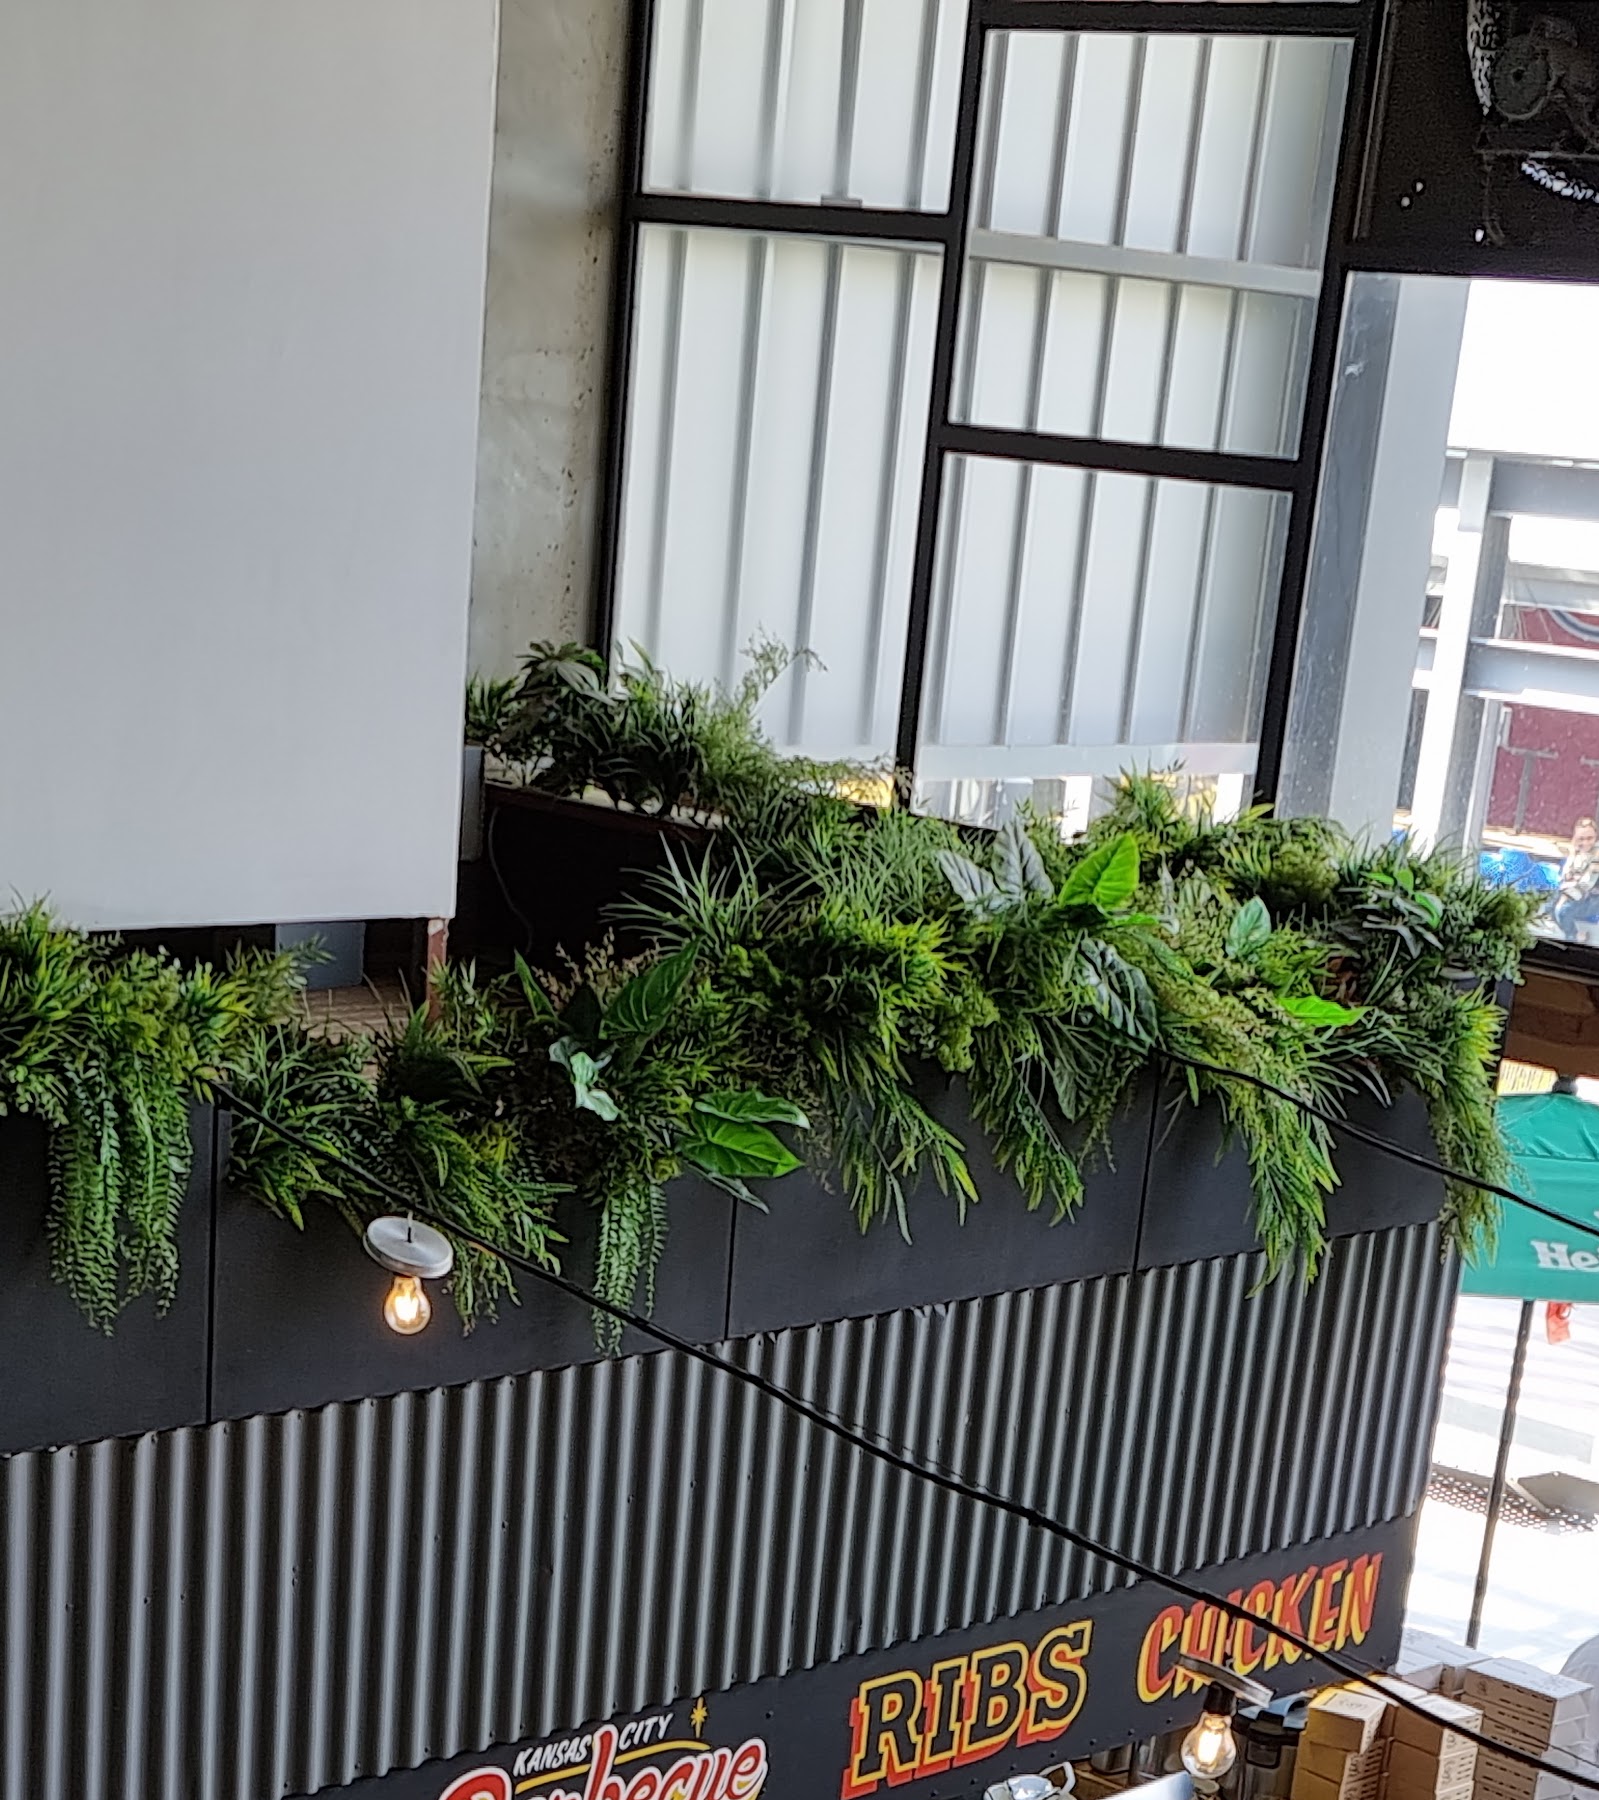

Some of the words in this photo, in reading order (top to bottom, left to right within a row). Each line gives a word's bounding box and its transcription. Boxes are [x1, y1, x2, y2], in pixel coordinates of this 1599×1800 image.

[1137, 1552, 1383, 1703] CHICKEN
[513, 1734, 592, 1777] KANSAS
[619, 1713, 674, 1751] CITY
[842, 1620, 1092, 1800] RIBS
